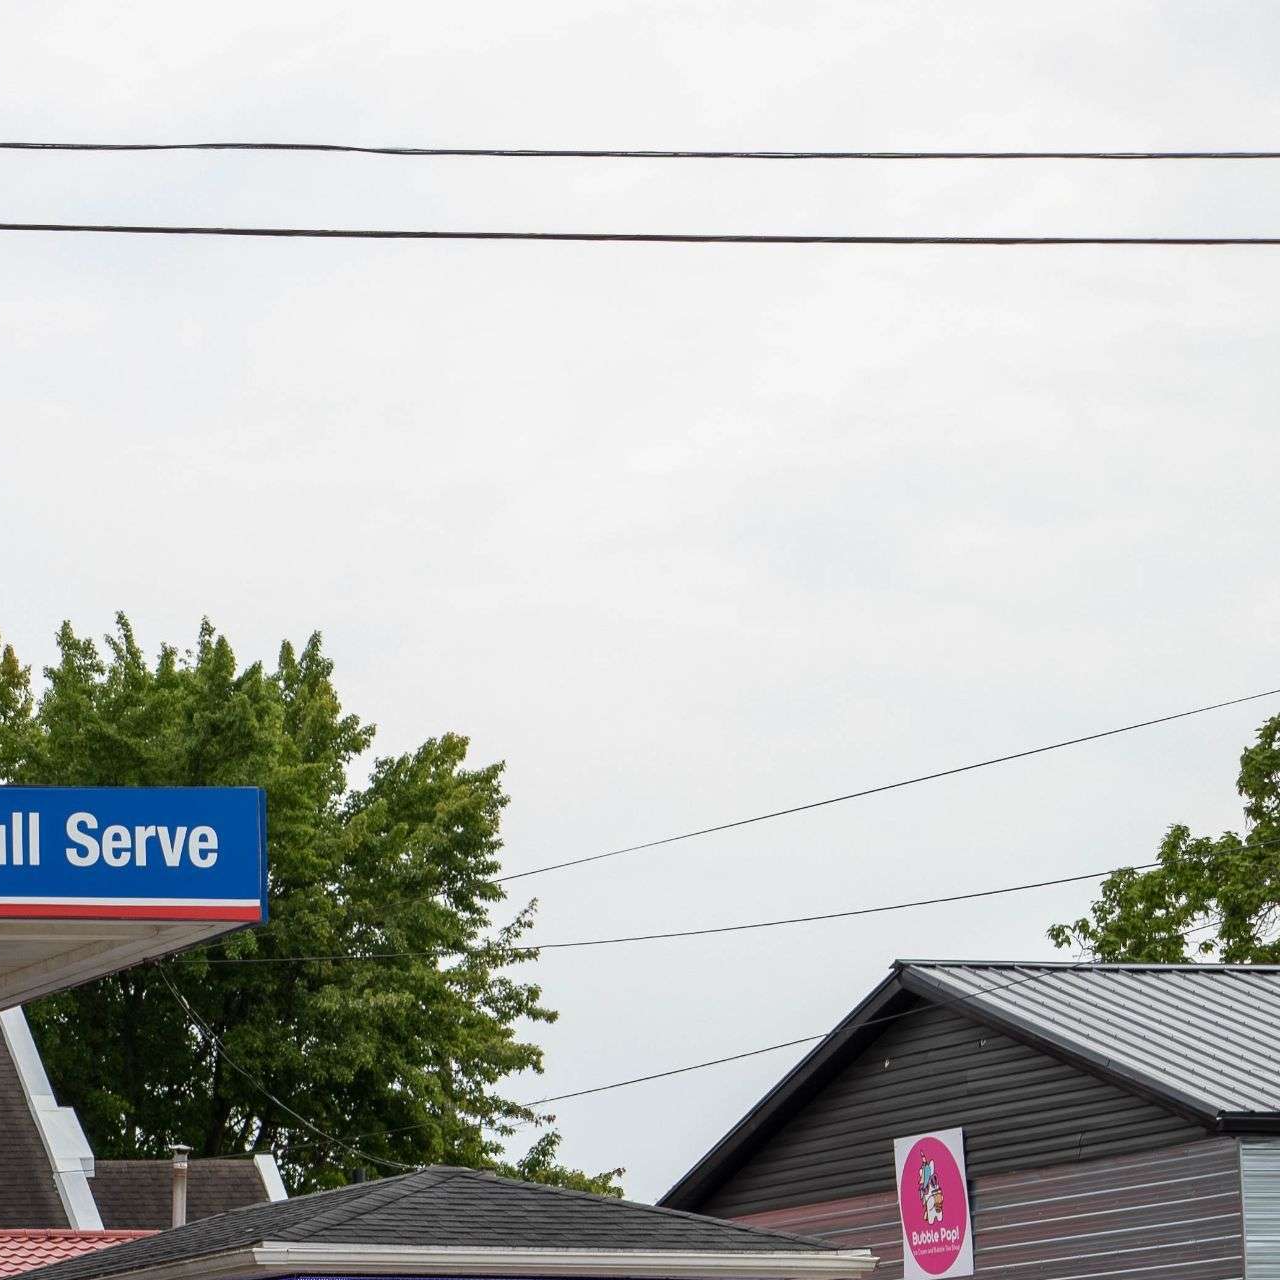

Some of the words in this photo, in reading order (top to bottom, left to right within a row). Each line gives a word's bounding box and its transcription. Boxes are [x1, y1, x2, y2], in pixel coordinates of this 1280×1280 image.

[65, 811, 219, 868] Serve
[912, 1229, 939, 1246] Bubble
[940, 1225, 960, 1243] Pop!
